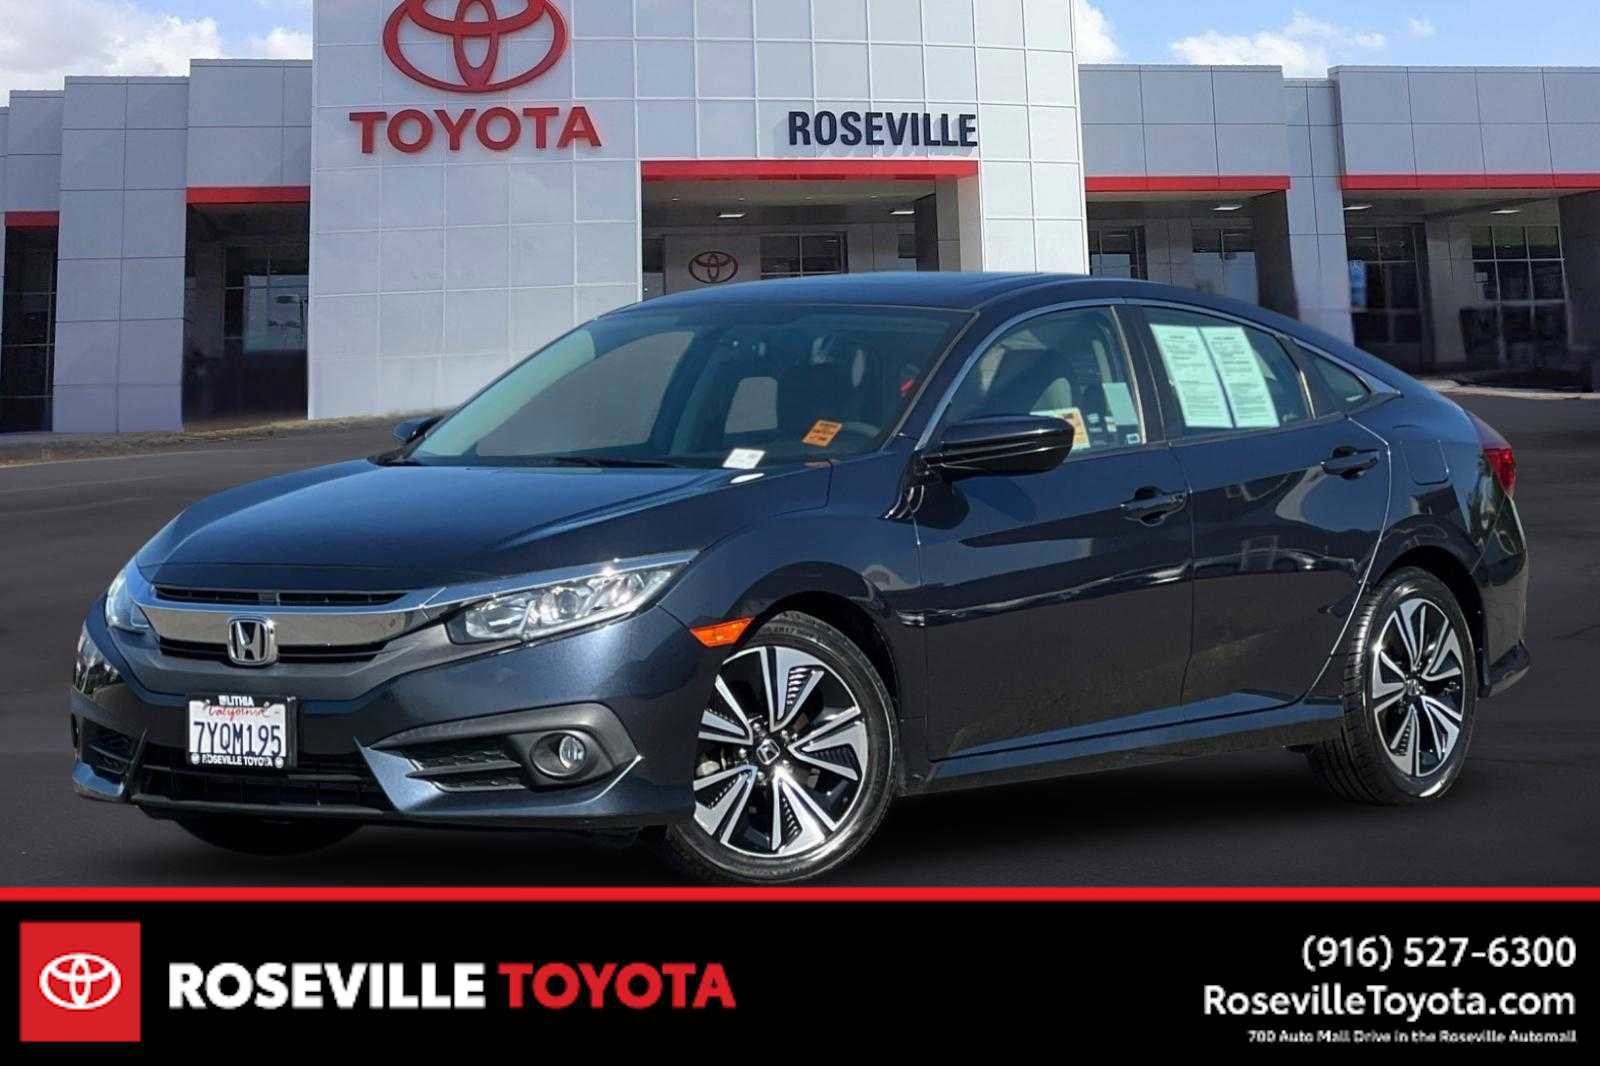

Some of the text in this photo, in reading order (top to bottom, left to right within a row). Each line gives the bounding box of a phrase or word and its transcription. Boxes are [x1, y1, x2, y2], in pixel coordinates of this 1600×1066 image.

[349, 105, 602, 155] TOYOTA
[789, 110, 979, 147] ROSEVILLE
[193, 721, 282, 758] 7YQM195
[201, 754, 273, 767] ROSEVILLE TOYOTA
